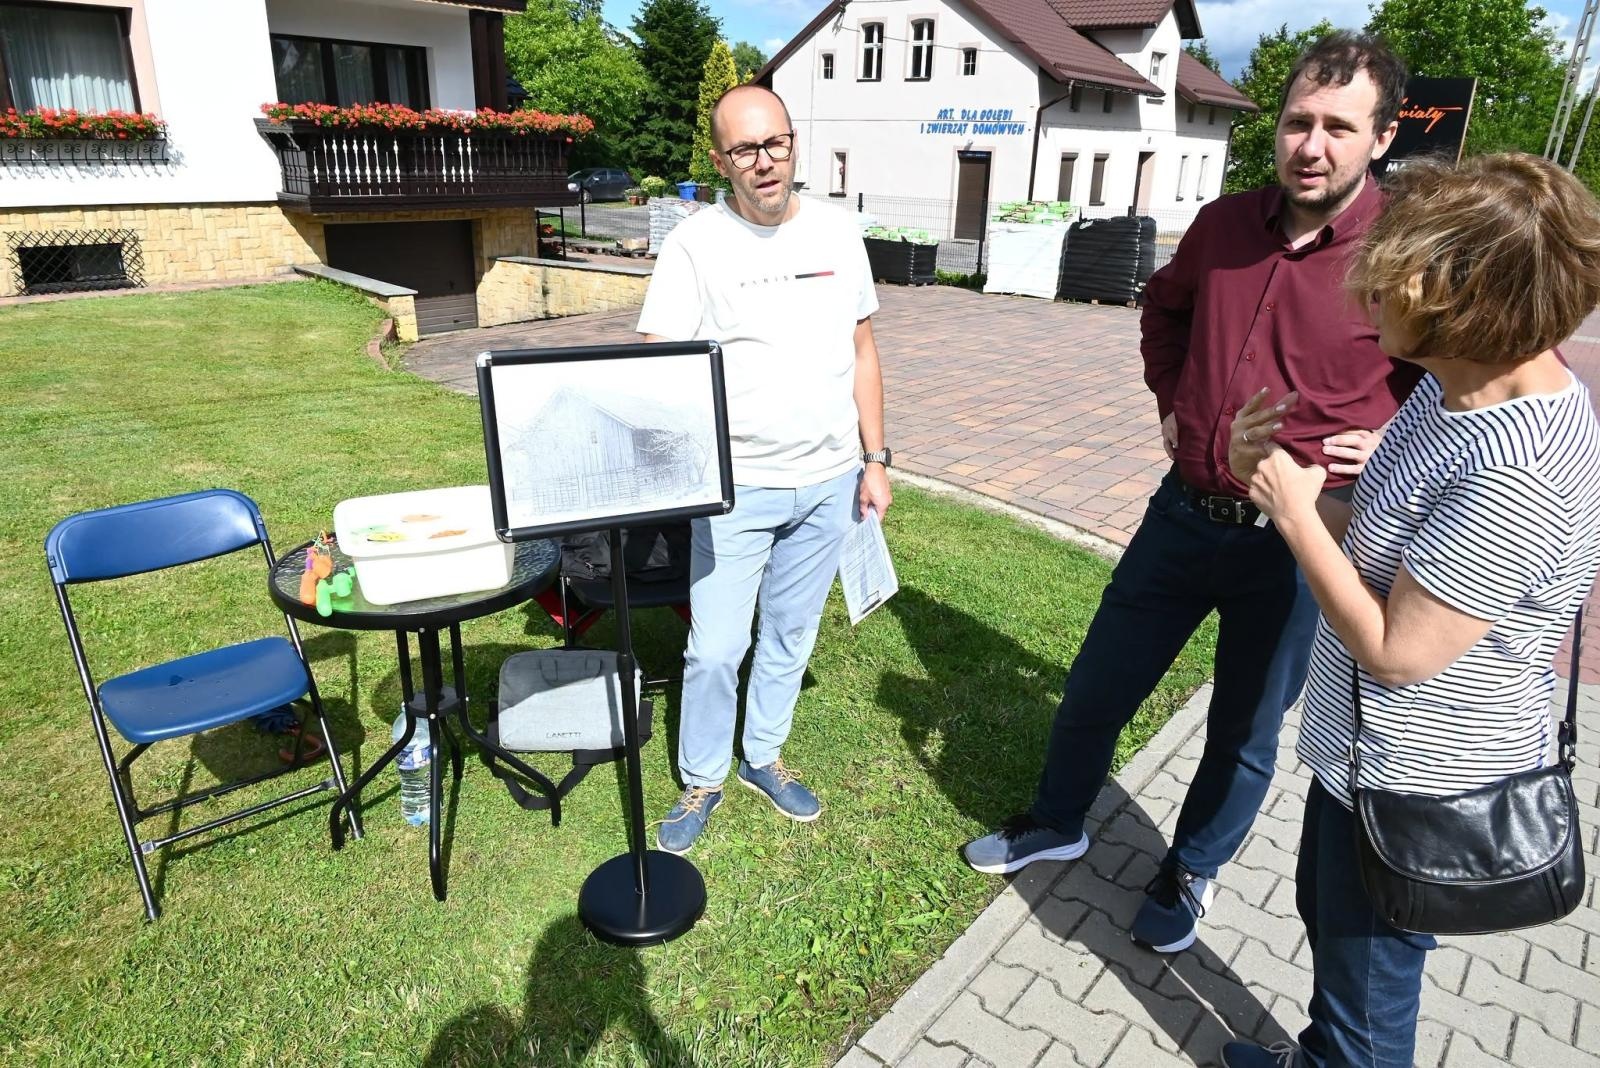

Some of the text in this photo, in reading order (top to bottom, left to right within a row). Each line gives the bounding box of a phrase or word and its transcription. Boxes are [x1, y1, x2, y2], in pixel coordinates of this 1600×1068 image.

[961, 109, 978, 121] DLA
[920, 122, 924, 134] I
[926, 122, 968, 136] ZWIERZĄT
